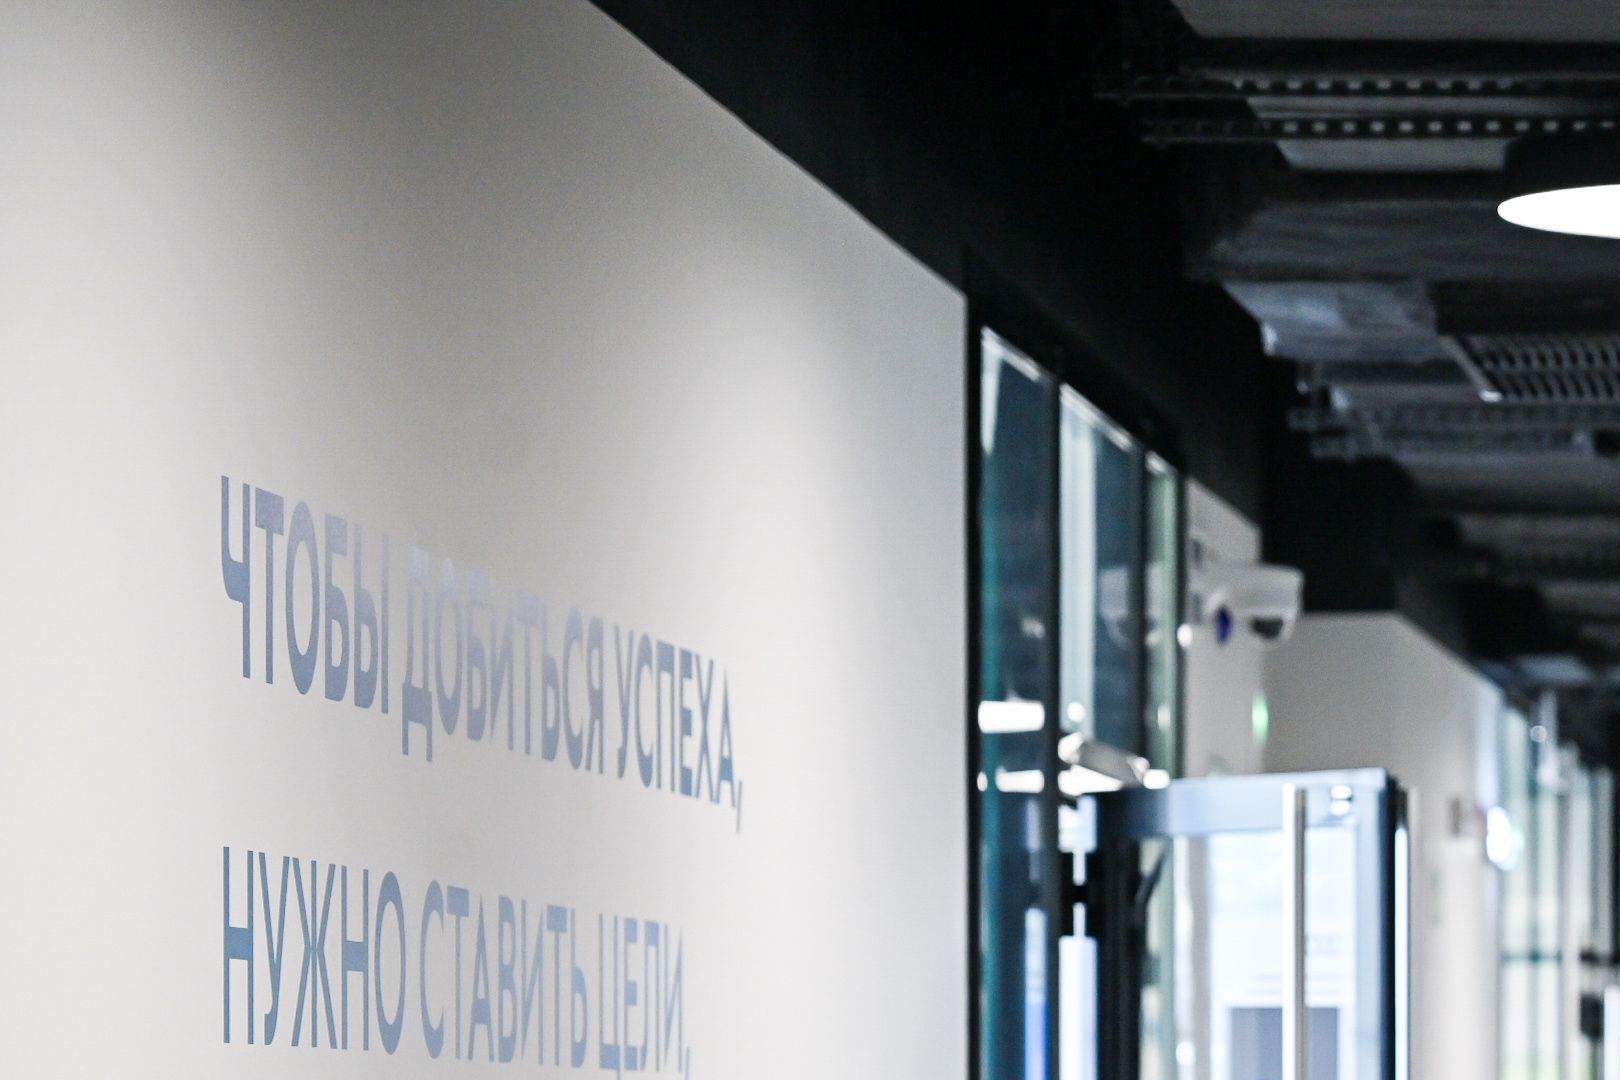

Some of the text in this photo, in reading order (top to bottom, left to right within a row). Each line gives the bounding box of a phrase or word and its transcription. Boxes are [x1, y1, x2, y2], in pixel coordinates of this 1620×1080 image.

[221, 475, 742, 834] ЧТОБЫ ДОБИТЬСЯ УСПЕХА,
[223, 845, 406, 1055] НУЖНО
[419, 879, 588, 1068] СТАВИТЬ
